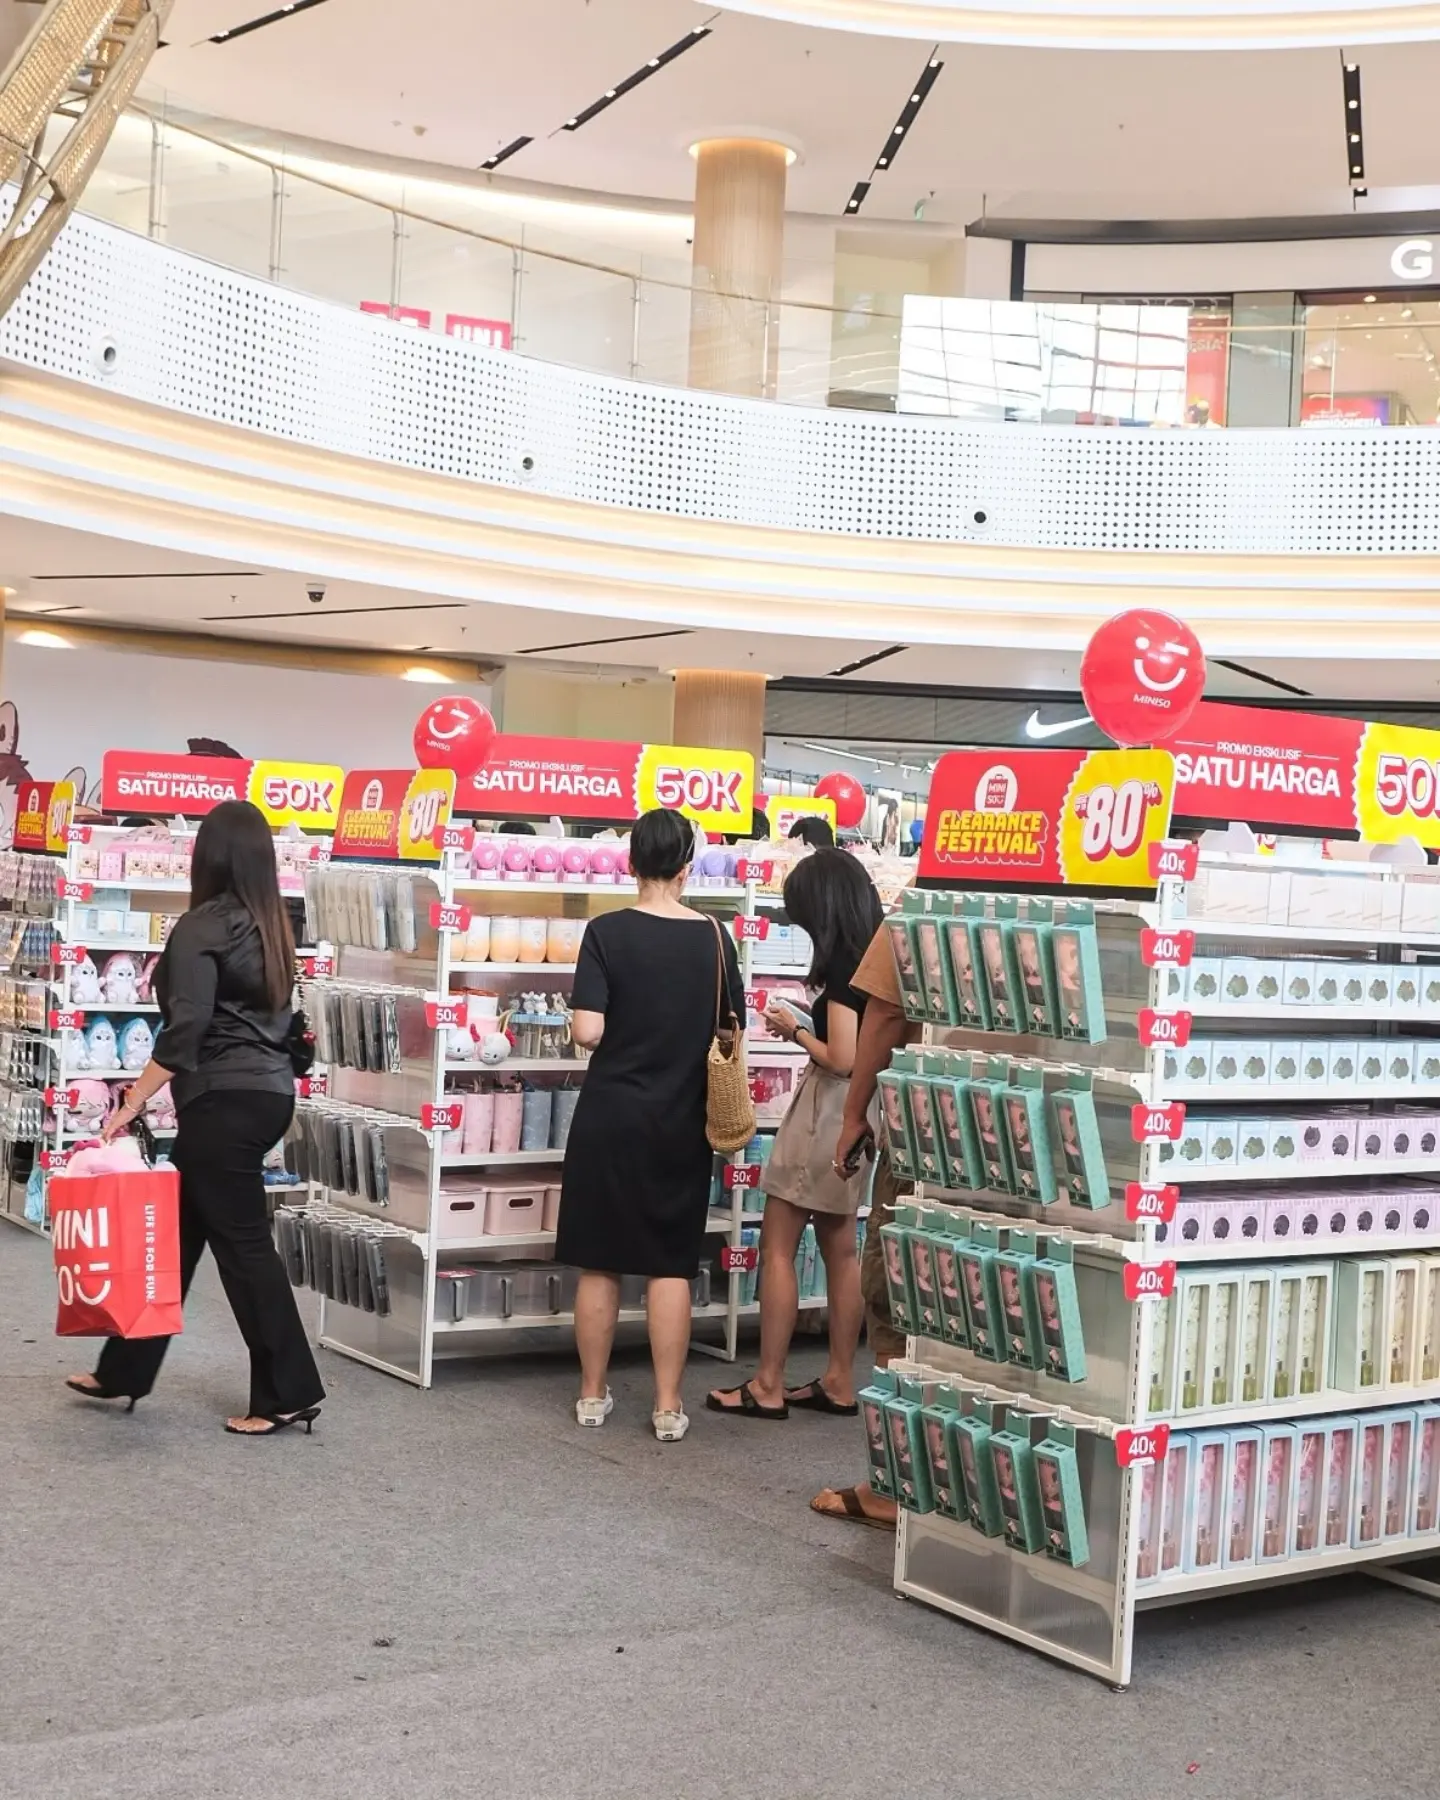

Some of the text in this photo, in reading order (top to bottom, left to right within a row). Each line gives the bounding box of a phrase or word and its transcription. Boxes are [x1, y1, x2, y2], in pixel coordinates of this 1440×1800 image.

[1133, 693, 1171, 709] MINISO
[1217, 741, 1303, 761] PROMO EKSKLUSIF
[509, 760, 541, 770] PROMO
[1175, 753, 1341, 797] SATU HARGA
[117, 777, 237, 800] SATU HARGA
[264, 777, 333, 811] 50K
[473, 770, 623, 798] SATU HARGA
[656, 766, 743, 811] 50K
[1377, 755, 1440, 816] 50
[343, 822, 391, 839] FESTIVAL
[939, 810, 1043, 833] CLEARANCE
[936, 831, 1039, 855] FESTIVAL
[144, 1204, 156, 1229] LIFE
[145, 1231, 156, 1244] IS
[145, 1247, 156, 1272] FOR
